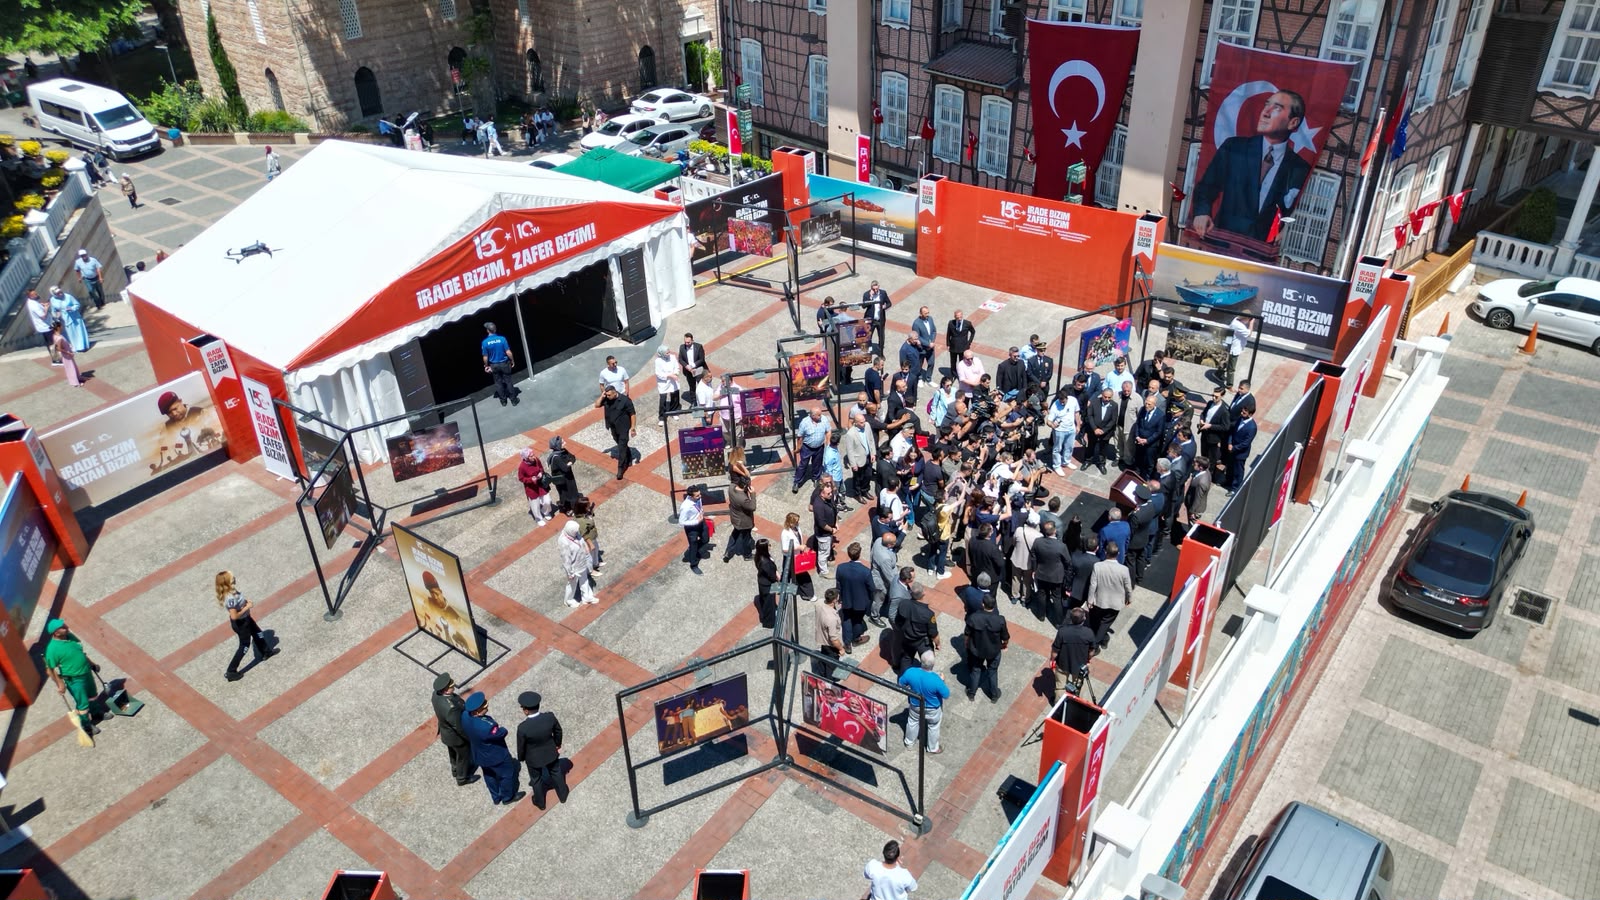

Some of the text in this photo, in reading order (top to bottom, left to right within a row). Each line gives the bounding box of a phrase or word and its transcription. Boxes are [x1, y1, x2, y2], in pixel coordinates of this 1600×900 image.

[1000, 200, 1016, 219] 15
[1026, 214, 1048, 225] ZAFER
[473, 228, 503, 260] 15
[512, 240, 554, 271] ZAFER
[261, 434, 284, 452] ZAFER
